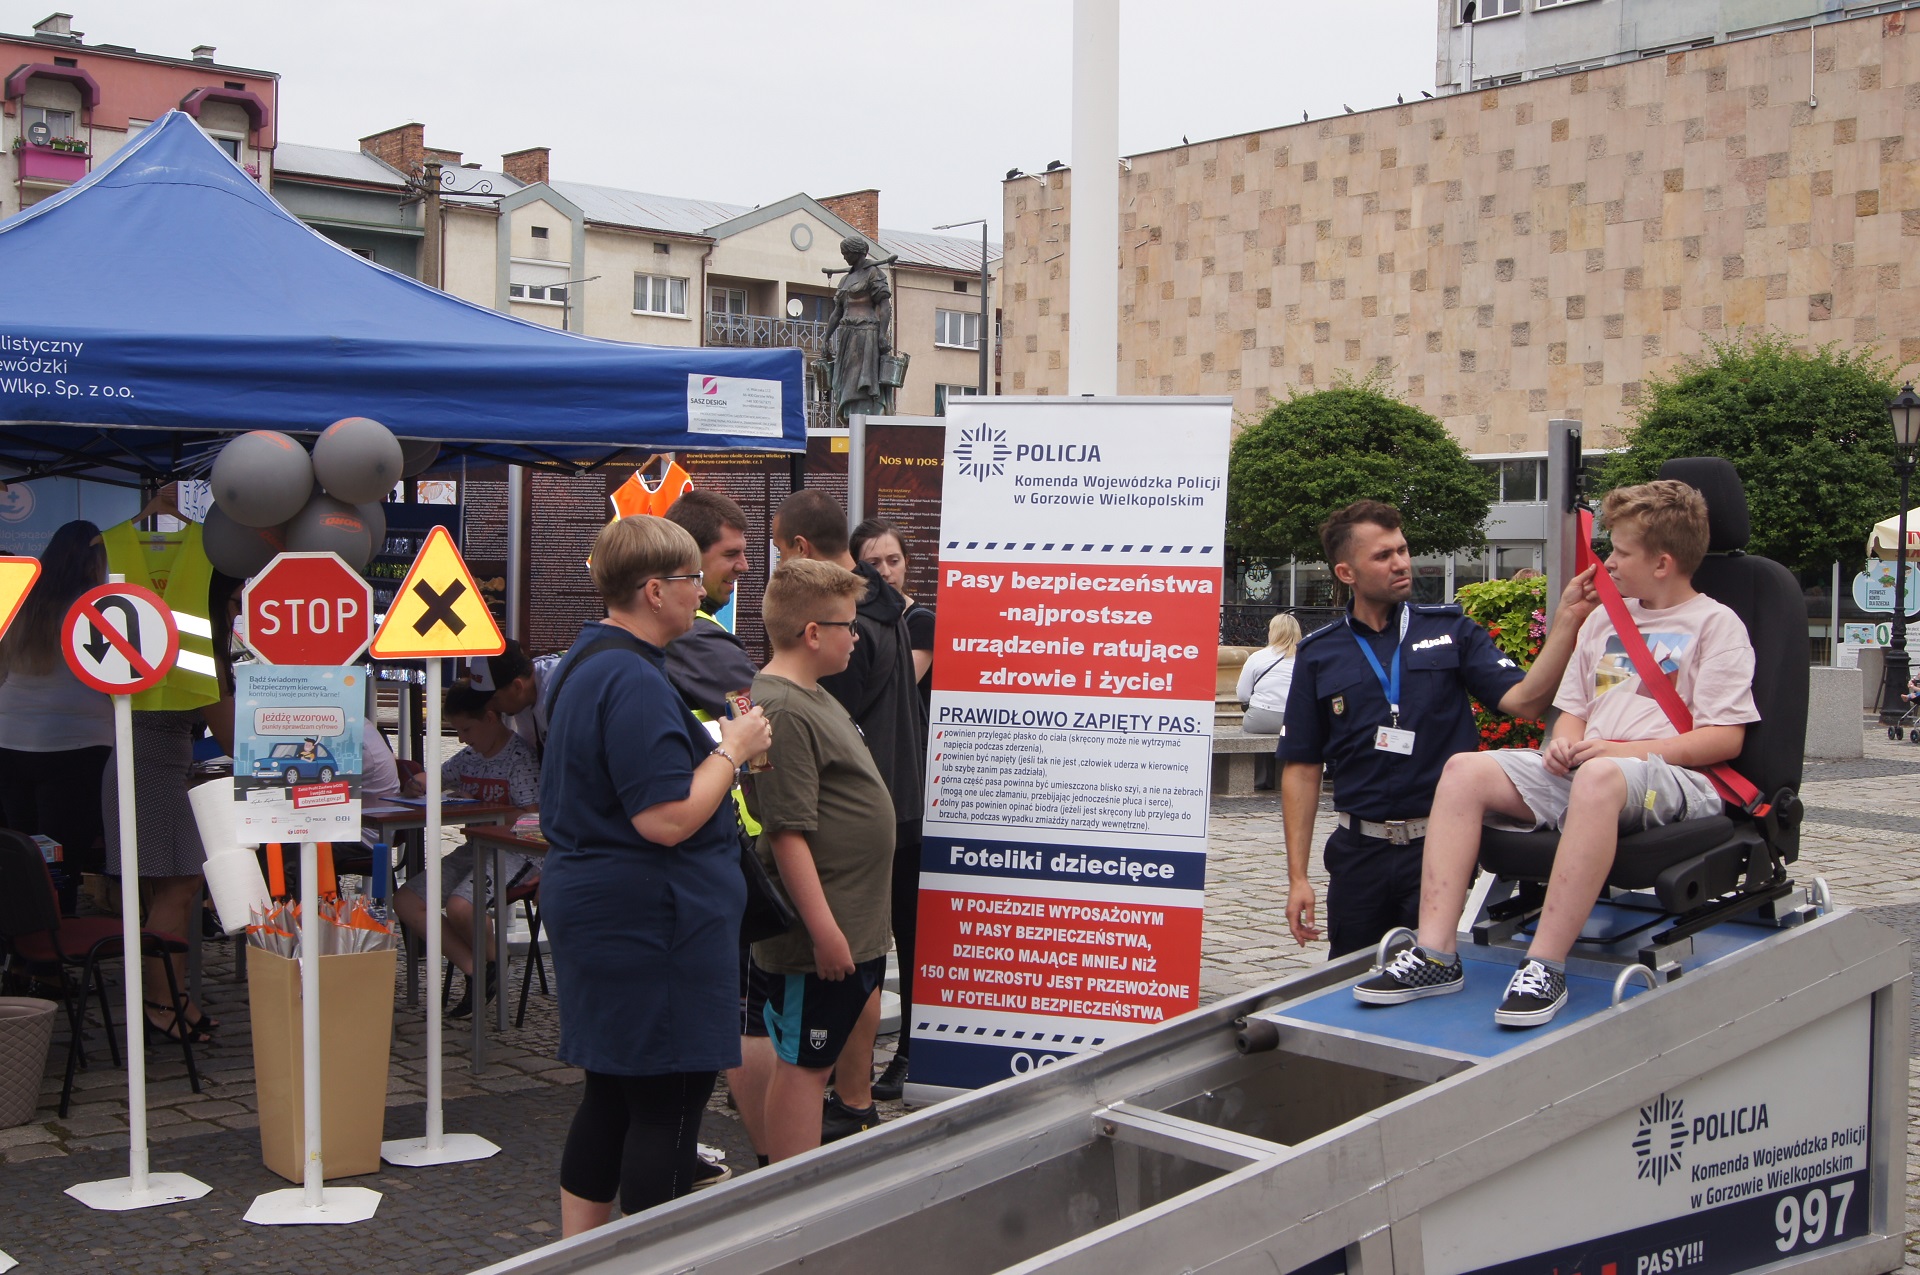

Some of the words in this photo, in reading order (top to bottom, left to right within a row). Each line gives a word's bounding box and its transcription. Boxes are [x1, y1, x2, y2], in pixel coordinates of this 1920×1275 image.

[0, 378, 50, 398] Wlkp.
[55, 380, 83, 399] Sp.
[89, 385, 98, 396] z
[103, 386, 134, 398] o.o.
[690, 397, 705, 405] SASZ
[879, 455, 901, 465] Nos
[904, 457, 914, 465] w
[917, 457, 937, 466] nos
[1016, 444, 1101, 462] POLICJA
[1015, 475, 1078, 487] Komenda
[1083, 475, 1172, 490] Wojewódzka
[1177, 476, 1220, 491] Policji
[1014, 494, 1025, 503] w
[1030, 492, 1094, 505] Gorzowie
[1100, 493, 1204, 508] Wielkopolskim
[946, 570, 1004, 592] Pasy
[1011, 571, 1213, 594] bezpieczeństwa
[259, 598, 358, 635] STOP
[999, 604, 1152, 626] -najprostsze
[952, 636, 1085, 657] urządzenie
[1093, 639, 1198, 663] ratujące
[979, 667, 1076, 688] zdrowie
[1084, 670, 1092, 688] i
[1099, 671, 1172, 694] życie!
[262, 712, 290, 724] Jeżdżę
[940, 707, 1067, 727] PRAWIDŁOWO
[1073, 712, 1152, 734] ZAPIĘTY
[1158, 716, 1200, 733] PAS:
[943, 741, 972, 750] napięcia
[974, 742, 1003, 751] podczas
[944, 729, 975, 738] powinien
[977, 730, 1011, 740] przylegać
[1013, 732, 1036, 740] płasko
[1049, 733, 1066, 741] ciała
[1069, 735, 1104, 745] (skręcony
[1107, 736, 1126, 744] może
[1128, 737, 1139, 745] nie
[1141, 738, 1181, 748] wytrzymać
[942, 753, 974, 762] powinien
[976, 754, 989, 763] być
[991, 755, 1016, 764] napięty
[1018, 755, 1035, 765] (jeśli
[1050, 757, 1061, 765] nie
[1063, 758, 1076, 767] jest
[1114, 760, 1138, 769] uderza
[1148, 762, 1188, 773] kierownicę
[942, 763, 953, 772] lub
[954, 764, 975, 774] szybę
[977, 766, 997, 774] zanim
[999, 767, 1012, 775] pas
[940, 787, 962, 796] (mogą
[979, 789, 993, 797] ulec
[995, 790, 1029, 800] złamaniu,
[1031, 792, 1070, 802] przebijając
[1072, 793, 1120, 804] jednocześnie
[1122, 797, 1142, 806] płuca
[941, 776, 961, 784] górna
[963, 777, 983, 786] część
[985, 778, 1001, 786] pasa
[1003, 779, 1033, 787] powinna
[1035, 780, 1048, 789] być
[1050, 780, 1098, 790] umieszczona
[1100, 783, 1122, 792] blisko
[1124, 785, 1140, 794] szyi,
[1149, 786, 1160, 794] nie
[1174, 787, 1203, 796] żebrach
[939, 810, 968, 820] brzucha,
[970, 812, 999, 821] podczas
[1001, 813, 1033, 823] wypadku
[1035, 814, 1069, 826] zmiażdży
[1071, 818, 1099, 828] narządy
[940, 798, 958, 808] dolny
[961, 800, 973, 808] pas
[975, 800, 1007, 810] powinien
[1009, 802, 1033, 811] opinać
[1035, 802, 1058, 812] biodra
[1060, 805, 1081, 815] (jeżeli
[1083, 806, 1096, 815] jest
[1098, 807, 1132, 818] skręcony
[1134, 809, 1145, 817] lub
[1147, 810, 1179, 821] przylega
[1181, 811, 1191, 820] do
[950, 846, 1042, 870] Foteliki
[1051, 853, 1174, 881] dziecięce
[950, 898, 963, 911] W
[967, 898, 1044, 917] POJEŹDZIE
[1049, 904, 1164, 925] WYPOSAŻONYM
[959, 922, 972, 934] W
[975, 923, 1012, 938] PASY
[1015, 926, 1152, 951] BEZPIECZEŃSTWA,
[953, 944, 1014, 961] DZIECKO
[1018, 949, 1077, 968] MAJĄCE
[1081, 954, 1127, 970] MNIEJ
[920, 964, 944, 979] 150
[948, 967, 969, 981] CM
[973, 968, 1042, 987] WZROSTU
[1046, 974, 1083, 990] JEST
[1087, 976, 1189, 999] PRZEWOŻONE
[941, 989, 954, 1001] W
[957, 990, 1027, 1009] FOTELIKU
[1031, 996, 1163, 1020] BEZPIECZEŃSTWA
[1692, 1103, 1768, 1144] POLICJA
[1691, 1154, 1748, 1182] Komenda
[1753, 1136, 1827, 1167] Wojewódzka
[1831, 1125, 1866, 1148] Policji
[1690, 1194, 1702, 1208] w
[1706, 1176, 1763, 1204] Gorzowie
[1767, 1155, 1852, 1189] Wielkopolskim
[1775, 1179, 1854, 1252] 997
[1637, 1240, 1703, 1275] PASY!!!
